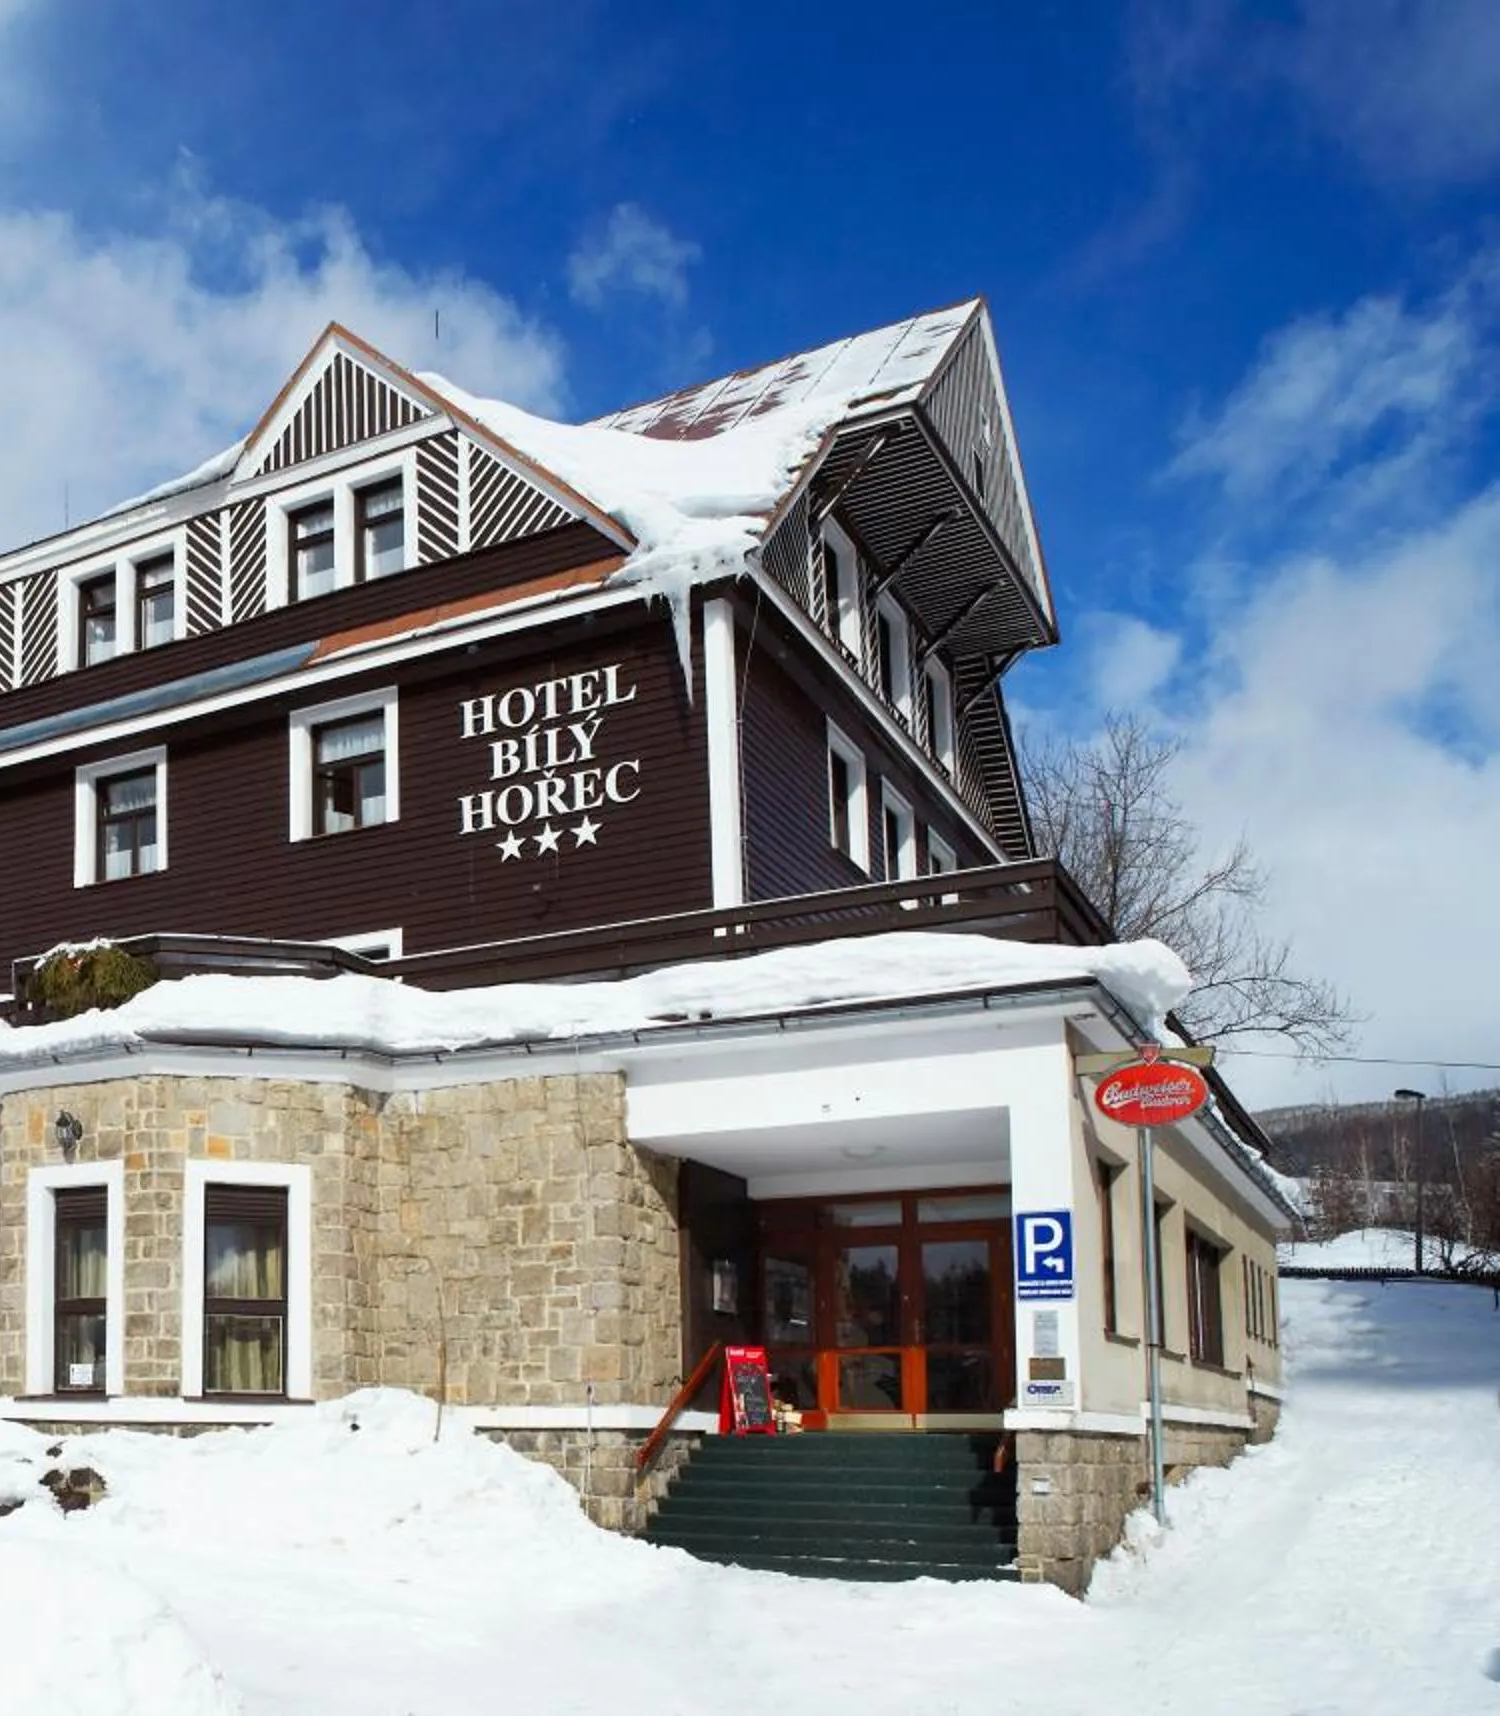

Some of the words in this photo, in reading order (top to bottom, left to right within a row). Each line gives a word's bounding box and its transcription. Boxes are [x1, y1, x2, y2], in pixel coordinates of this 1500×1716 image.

[460, 663, 637, 739] HOTEL
[489, 710, 604, 781] BÍLÝ
[458, 759, 641, 835] HOŘEC
[1024, 1217, 1064, 1275] P
